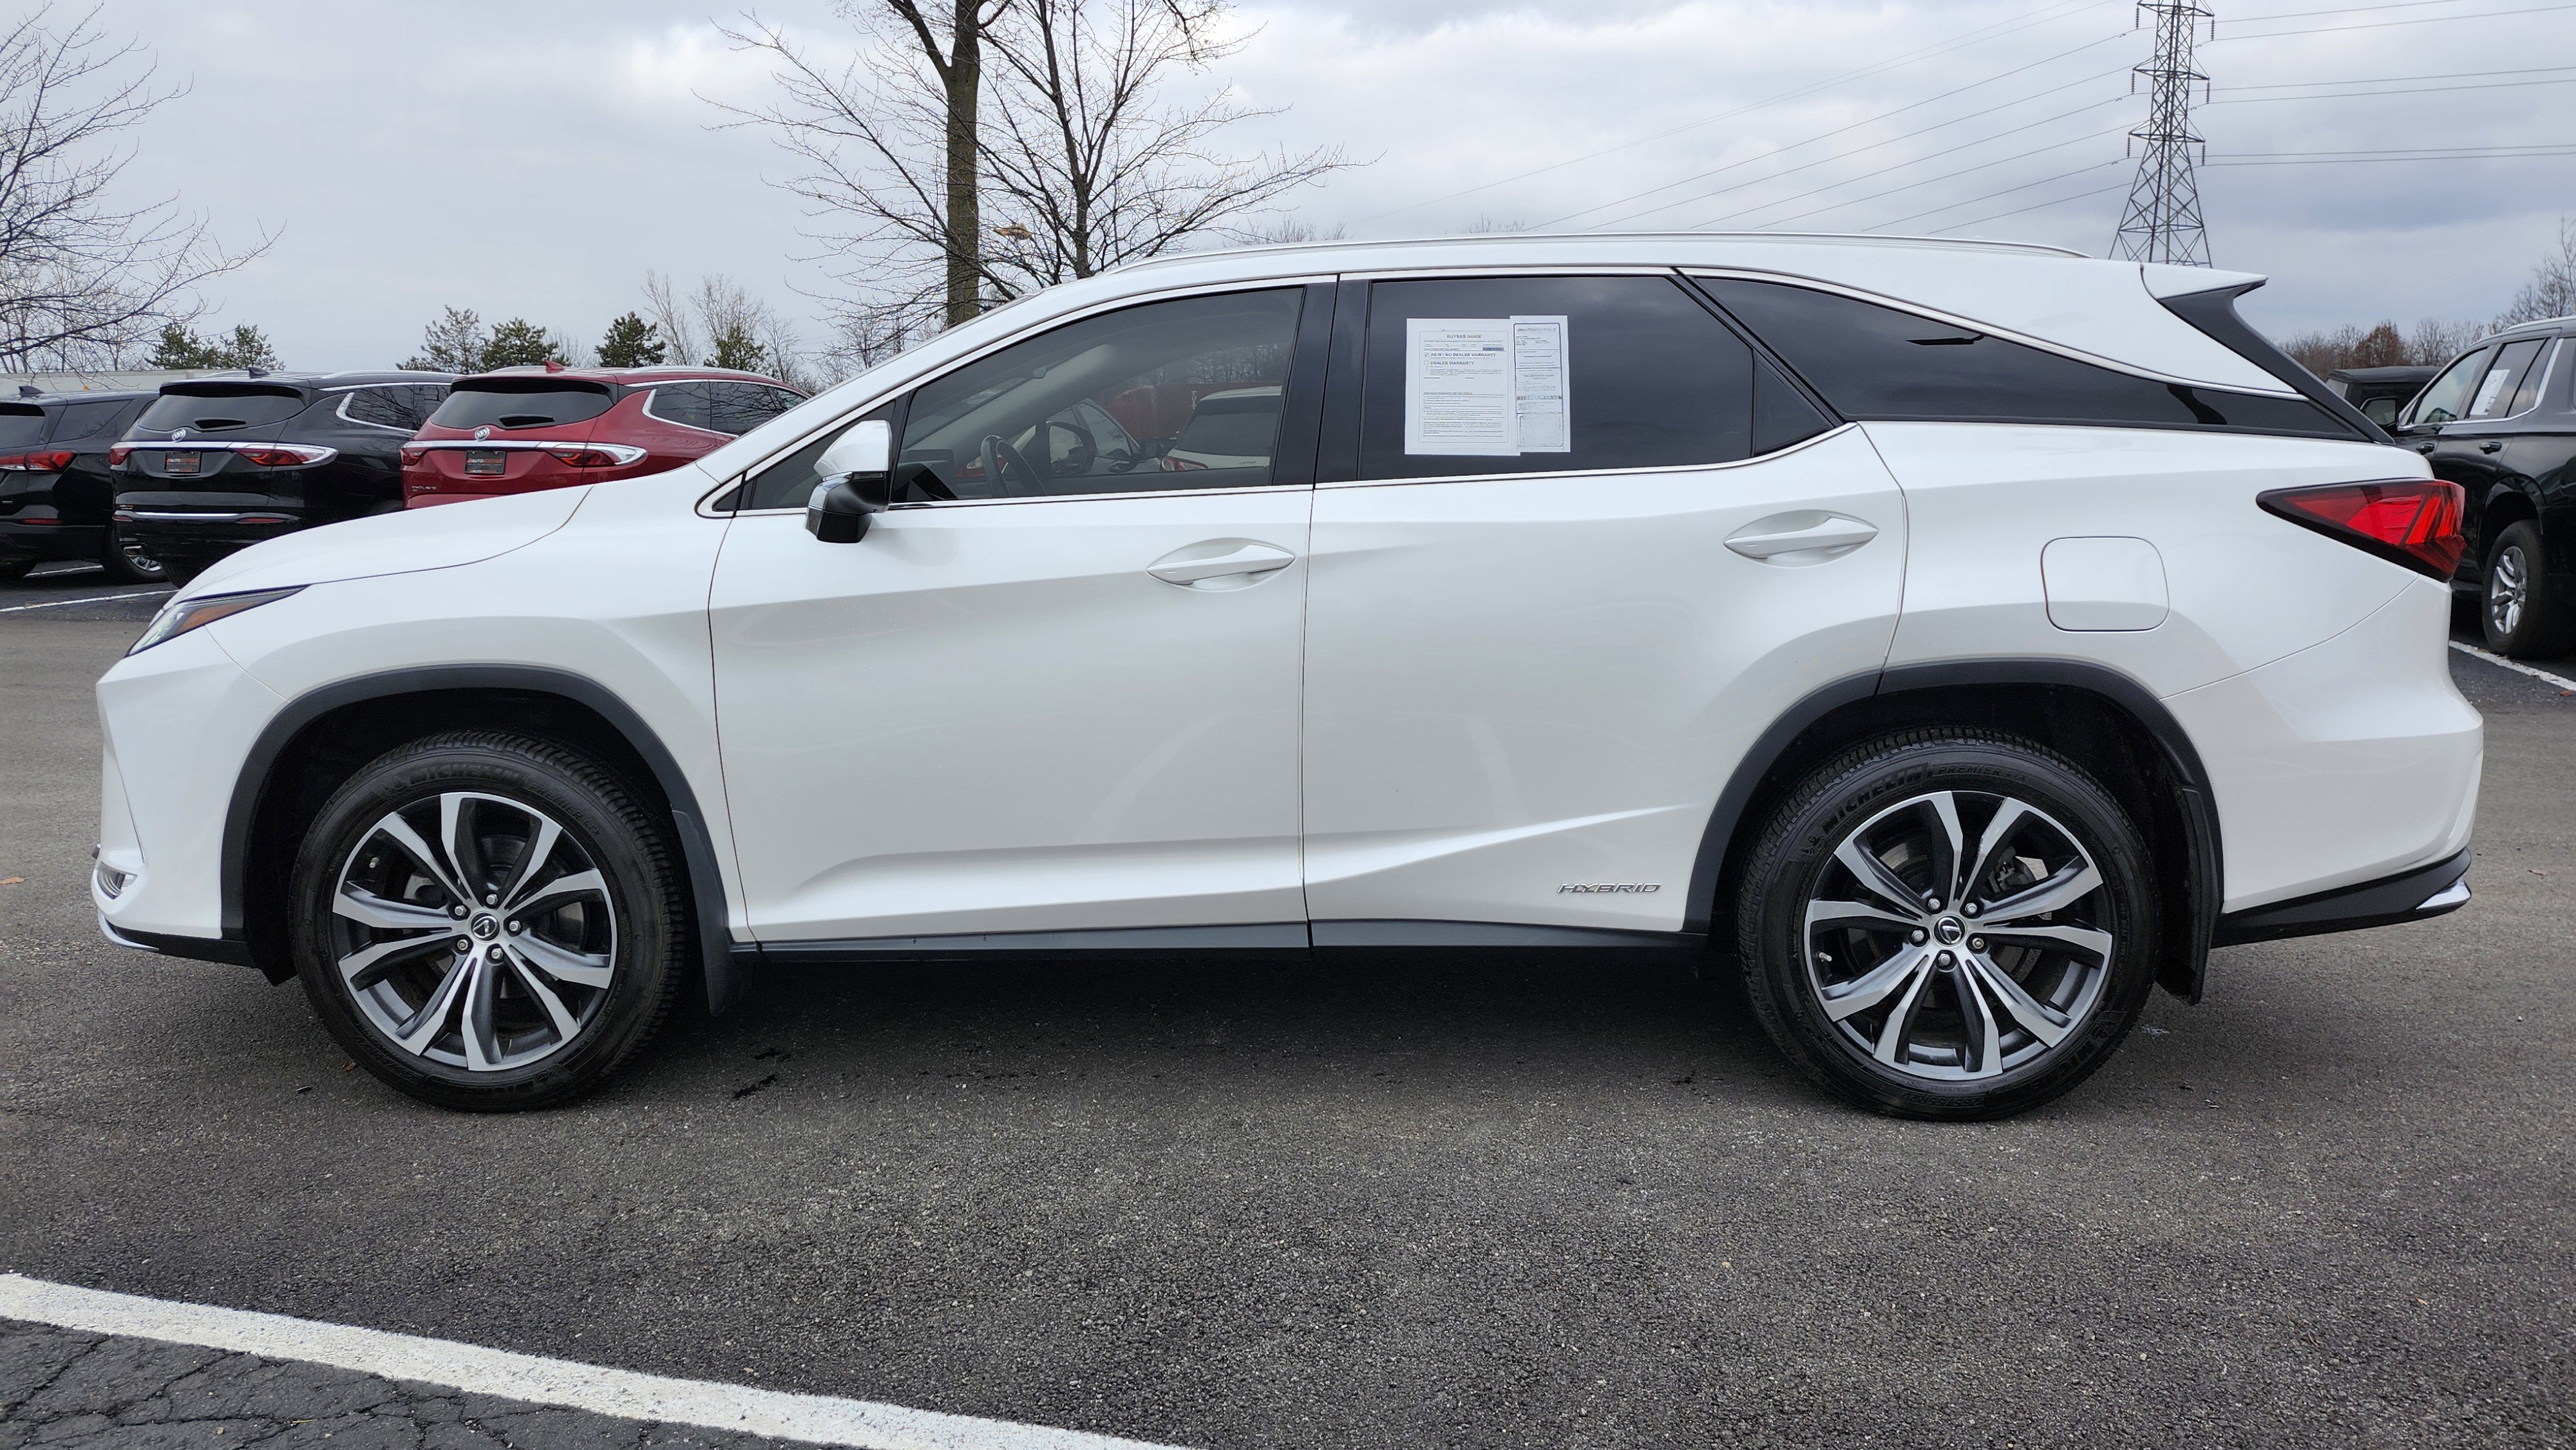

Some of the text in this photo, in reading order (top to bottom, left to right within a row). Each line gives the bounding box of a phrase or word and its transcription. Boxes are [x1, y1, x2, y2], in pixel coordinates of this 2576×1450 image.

[530, 784, 583, 819] PREMIER
[582, 814, 601, 836] LTX
[1821, 763, 1928, 835] MICHELIN
[1938, 765, 2002, 775] PREMIER
[1557, 882, 1662, 894] HYBRID
